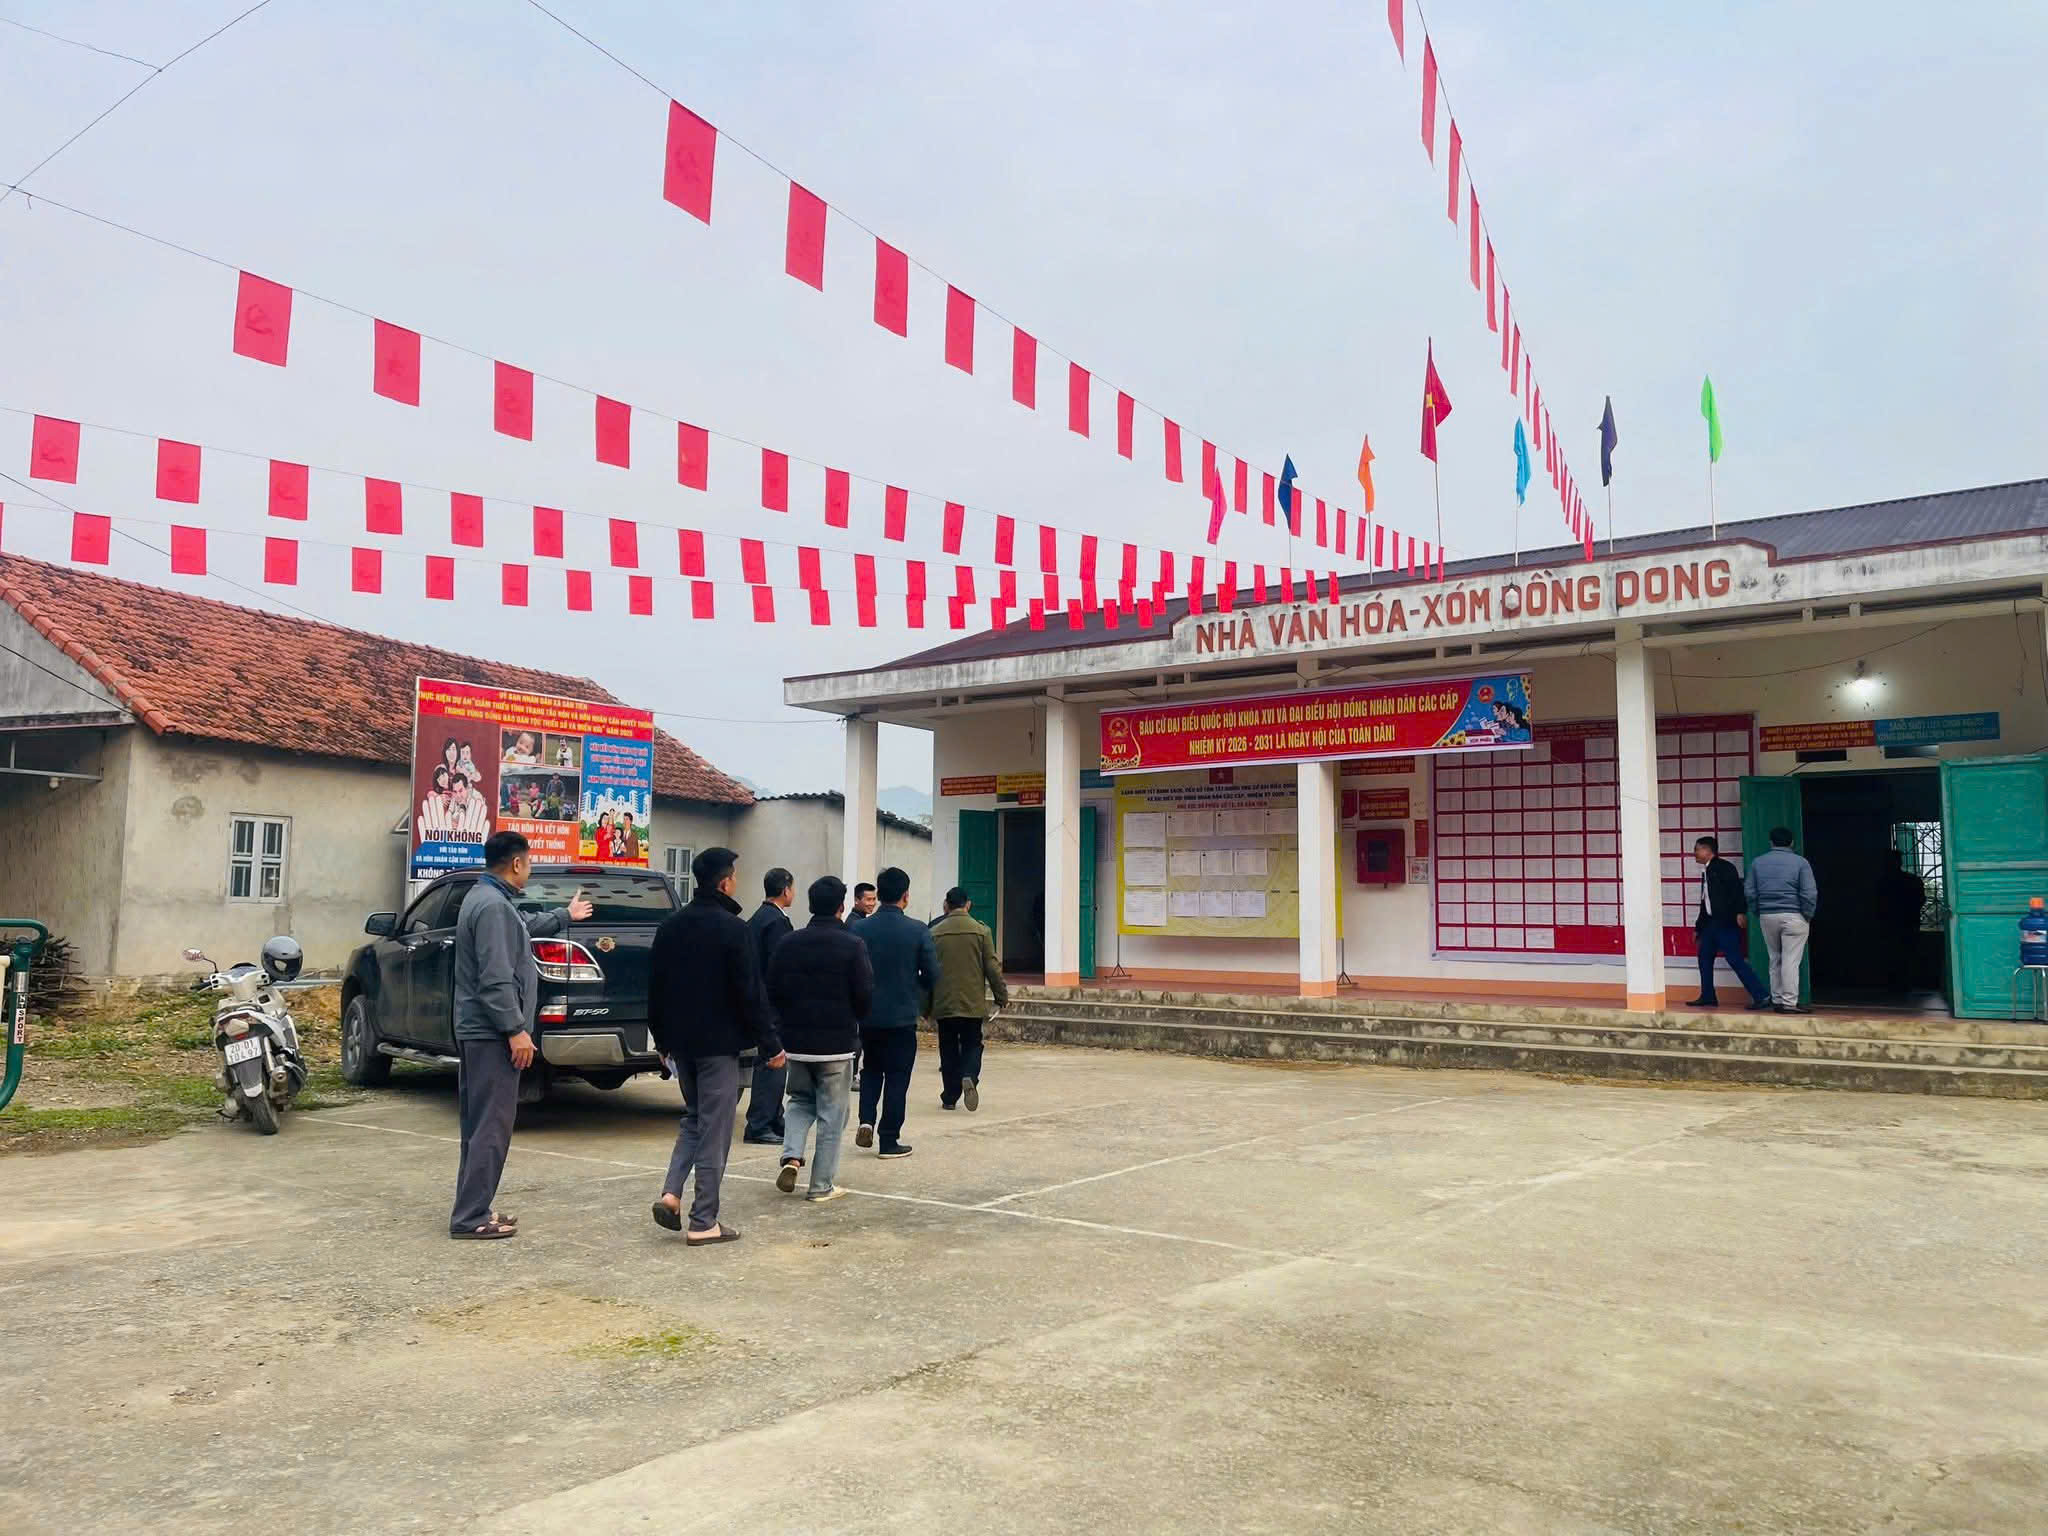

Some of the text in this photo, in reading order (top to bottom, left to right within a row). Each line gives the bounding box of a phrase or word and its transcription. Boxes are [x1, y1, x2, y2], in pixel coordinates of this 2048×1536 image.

[1196, 611, 1256, 654] NHÀ
[1268, 604, 1328, 646] VĂN
[1616, 559, 1730, 608] DONG
[1139, 688, 1458, 736] BẦU CỬ ĐẠI BIỂU QUỐC HỘI KHÓA XVI VÀ ĐẠI BIỂU HỘI ĐỒNG NHÂN DÂN CÁC CẤP
[1111, 743, 1127, 755] XVI
[1189, 735, 1215, 757] NHIỆM
[1227, 736, 1247, 752] 2026
[1254, 735, 1273, 750] 2031
[1275, 730, 1286, 749] LÀ
[1288, 728, 1310, 748] NGÀY
[1312, 727, 1327, 750] HỘI
[1329, 723, 1346, 745] CỦA
[1348, 724, 1371, 744] TOÀN
[1373, 722, 1395, 742] DÂN!
[425, 828, 482, 843] NÓI KHÔNG
[16, 1009, 25, 1043] SPORT
[573, 1008, 609, 1017] BT-50
